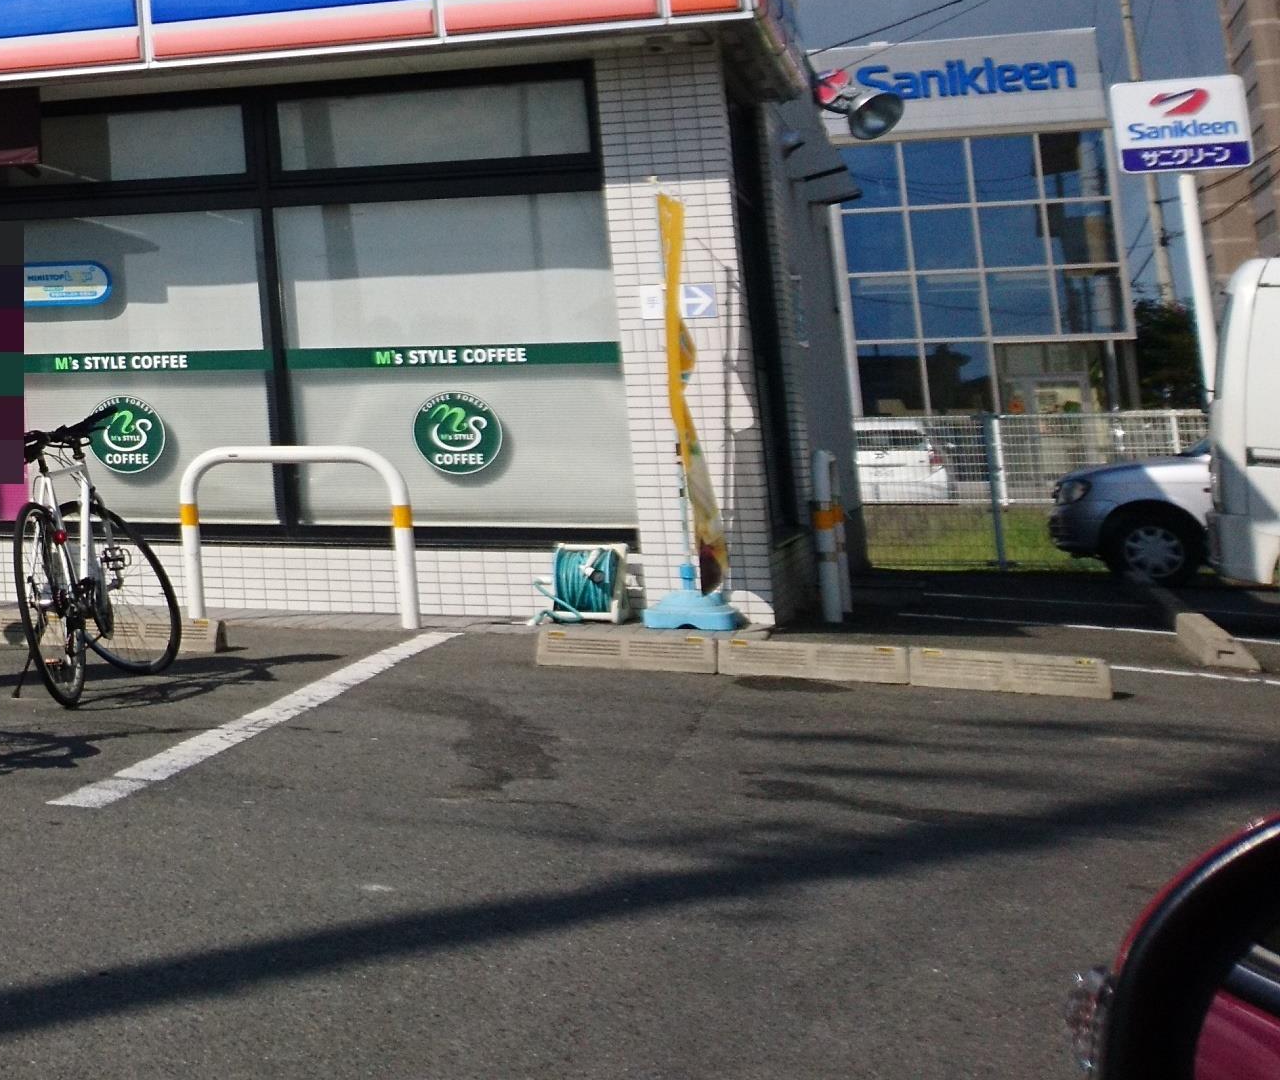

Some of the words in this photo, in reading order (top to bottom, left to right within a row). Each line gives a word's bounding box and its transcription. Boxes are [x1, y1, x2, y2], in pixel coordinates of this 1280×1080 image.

[856, 57, 1077, 99] Sanikleen
[1128, 119, 1238, 141] Sanikleen
[1141, 146, 1231, 168] サニクリーン
[55, 356, 80, 370] M's
[84, 355, 126, 369] STYLE
[131, 354, 188, 369] COFFEE
[376, 350, 403, 365] M's
[408, 349, 457, 364] STYLE
[462, 348, 527, 363] COFFEE
[125, 397, 154, 415] FOREST
[422, 394, 451, 412] COFFEE
[457, 393, 488, 412] FOREST
[105, 453, 149, 464] COFFEE
[435, 453, 484, 465] COFFEE
